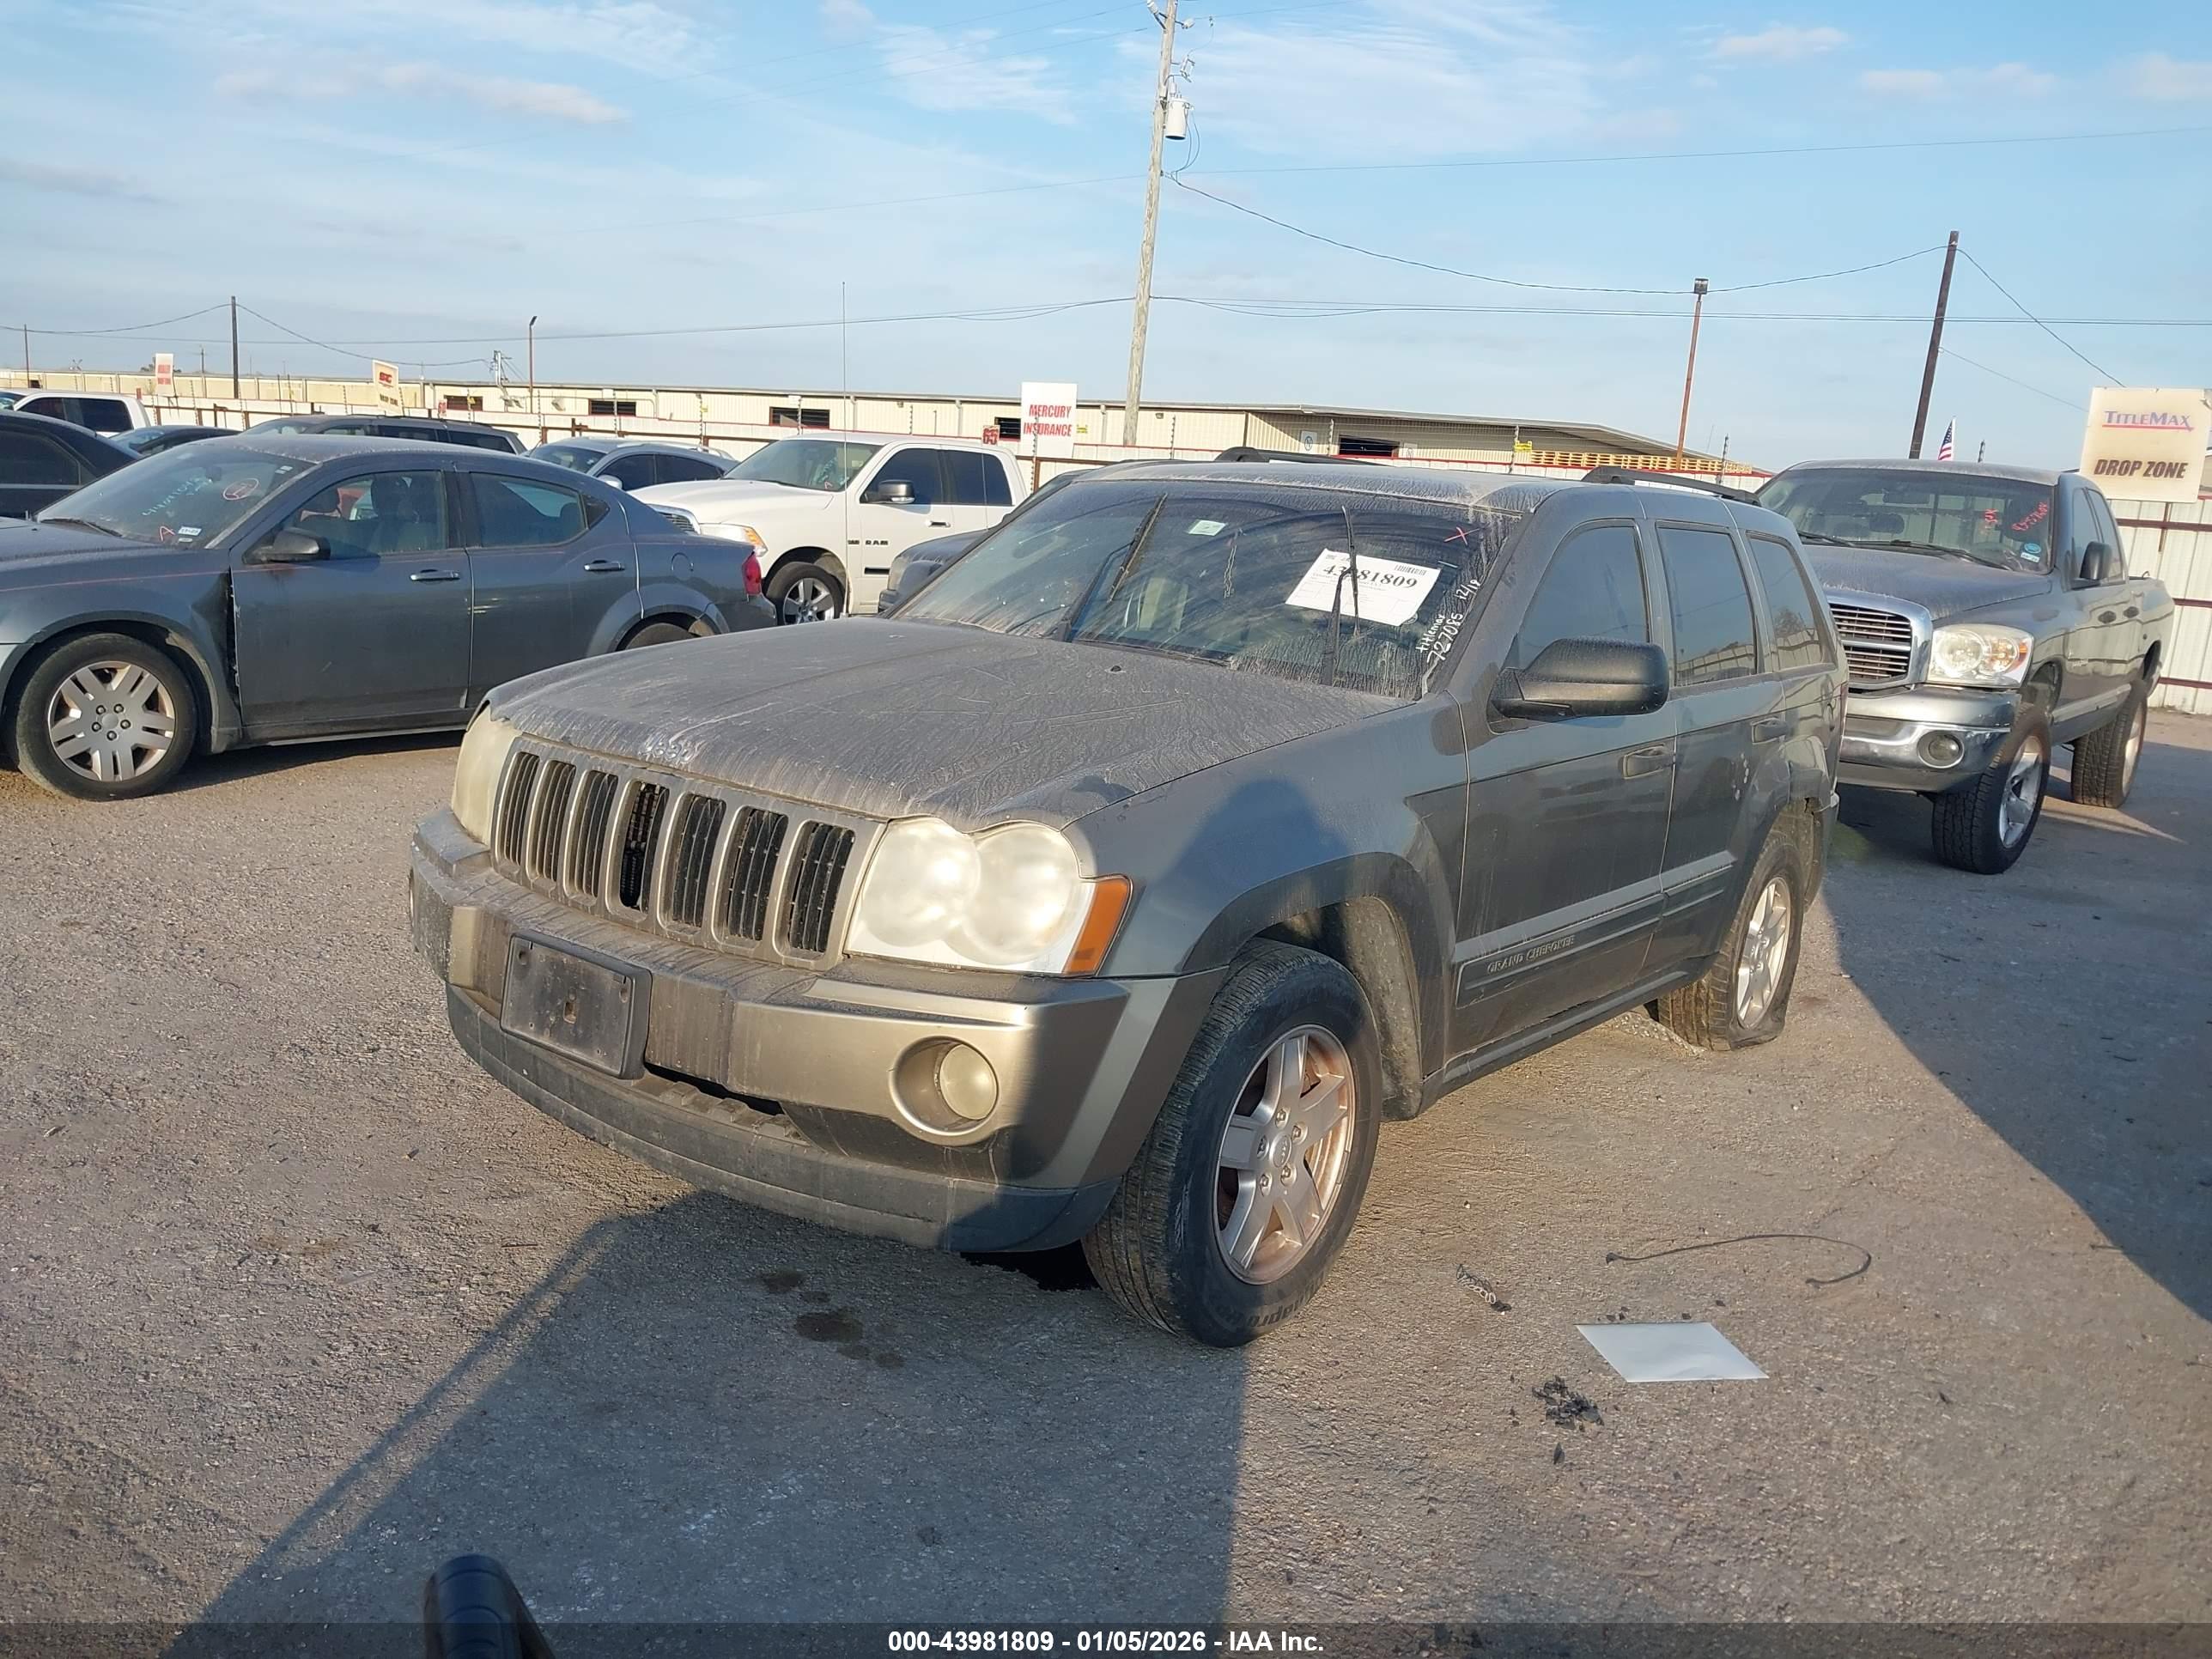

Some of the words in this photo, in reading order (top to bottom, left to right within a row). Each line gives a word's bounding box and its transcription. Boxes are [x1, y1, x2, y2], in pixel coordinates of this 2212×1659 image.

[1029, 404, 1073, 418] MERCURY
[1023, 422, 1073, 437] INSURANCE
[2094, 459, 2143, 477] DROP
[2142, 460, 2190, 479] ZONE
[1323, 563, 1419, 589] 4381809
[1426, 612, 1464, 664] 727085
[1487, 953, 1524, 975] GRAND
[1526, 934, 1577, 961] CHEROKEE
